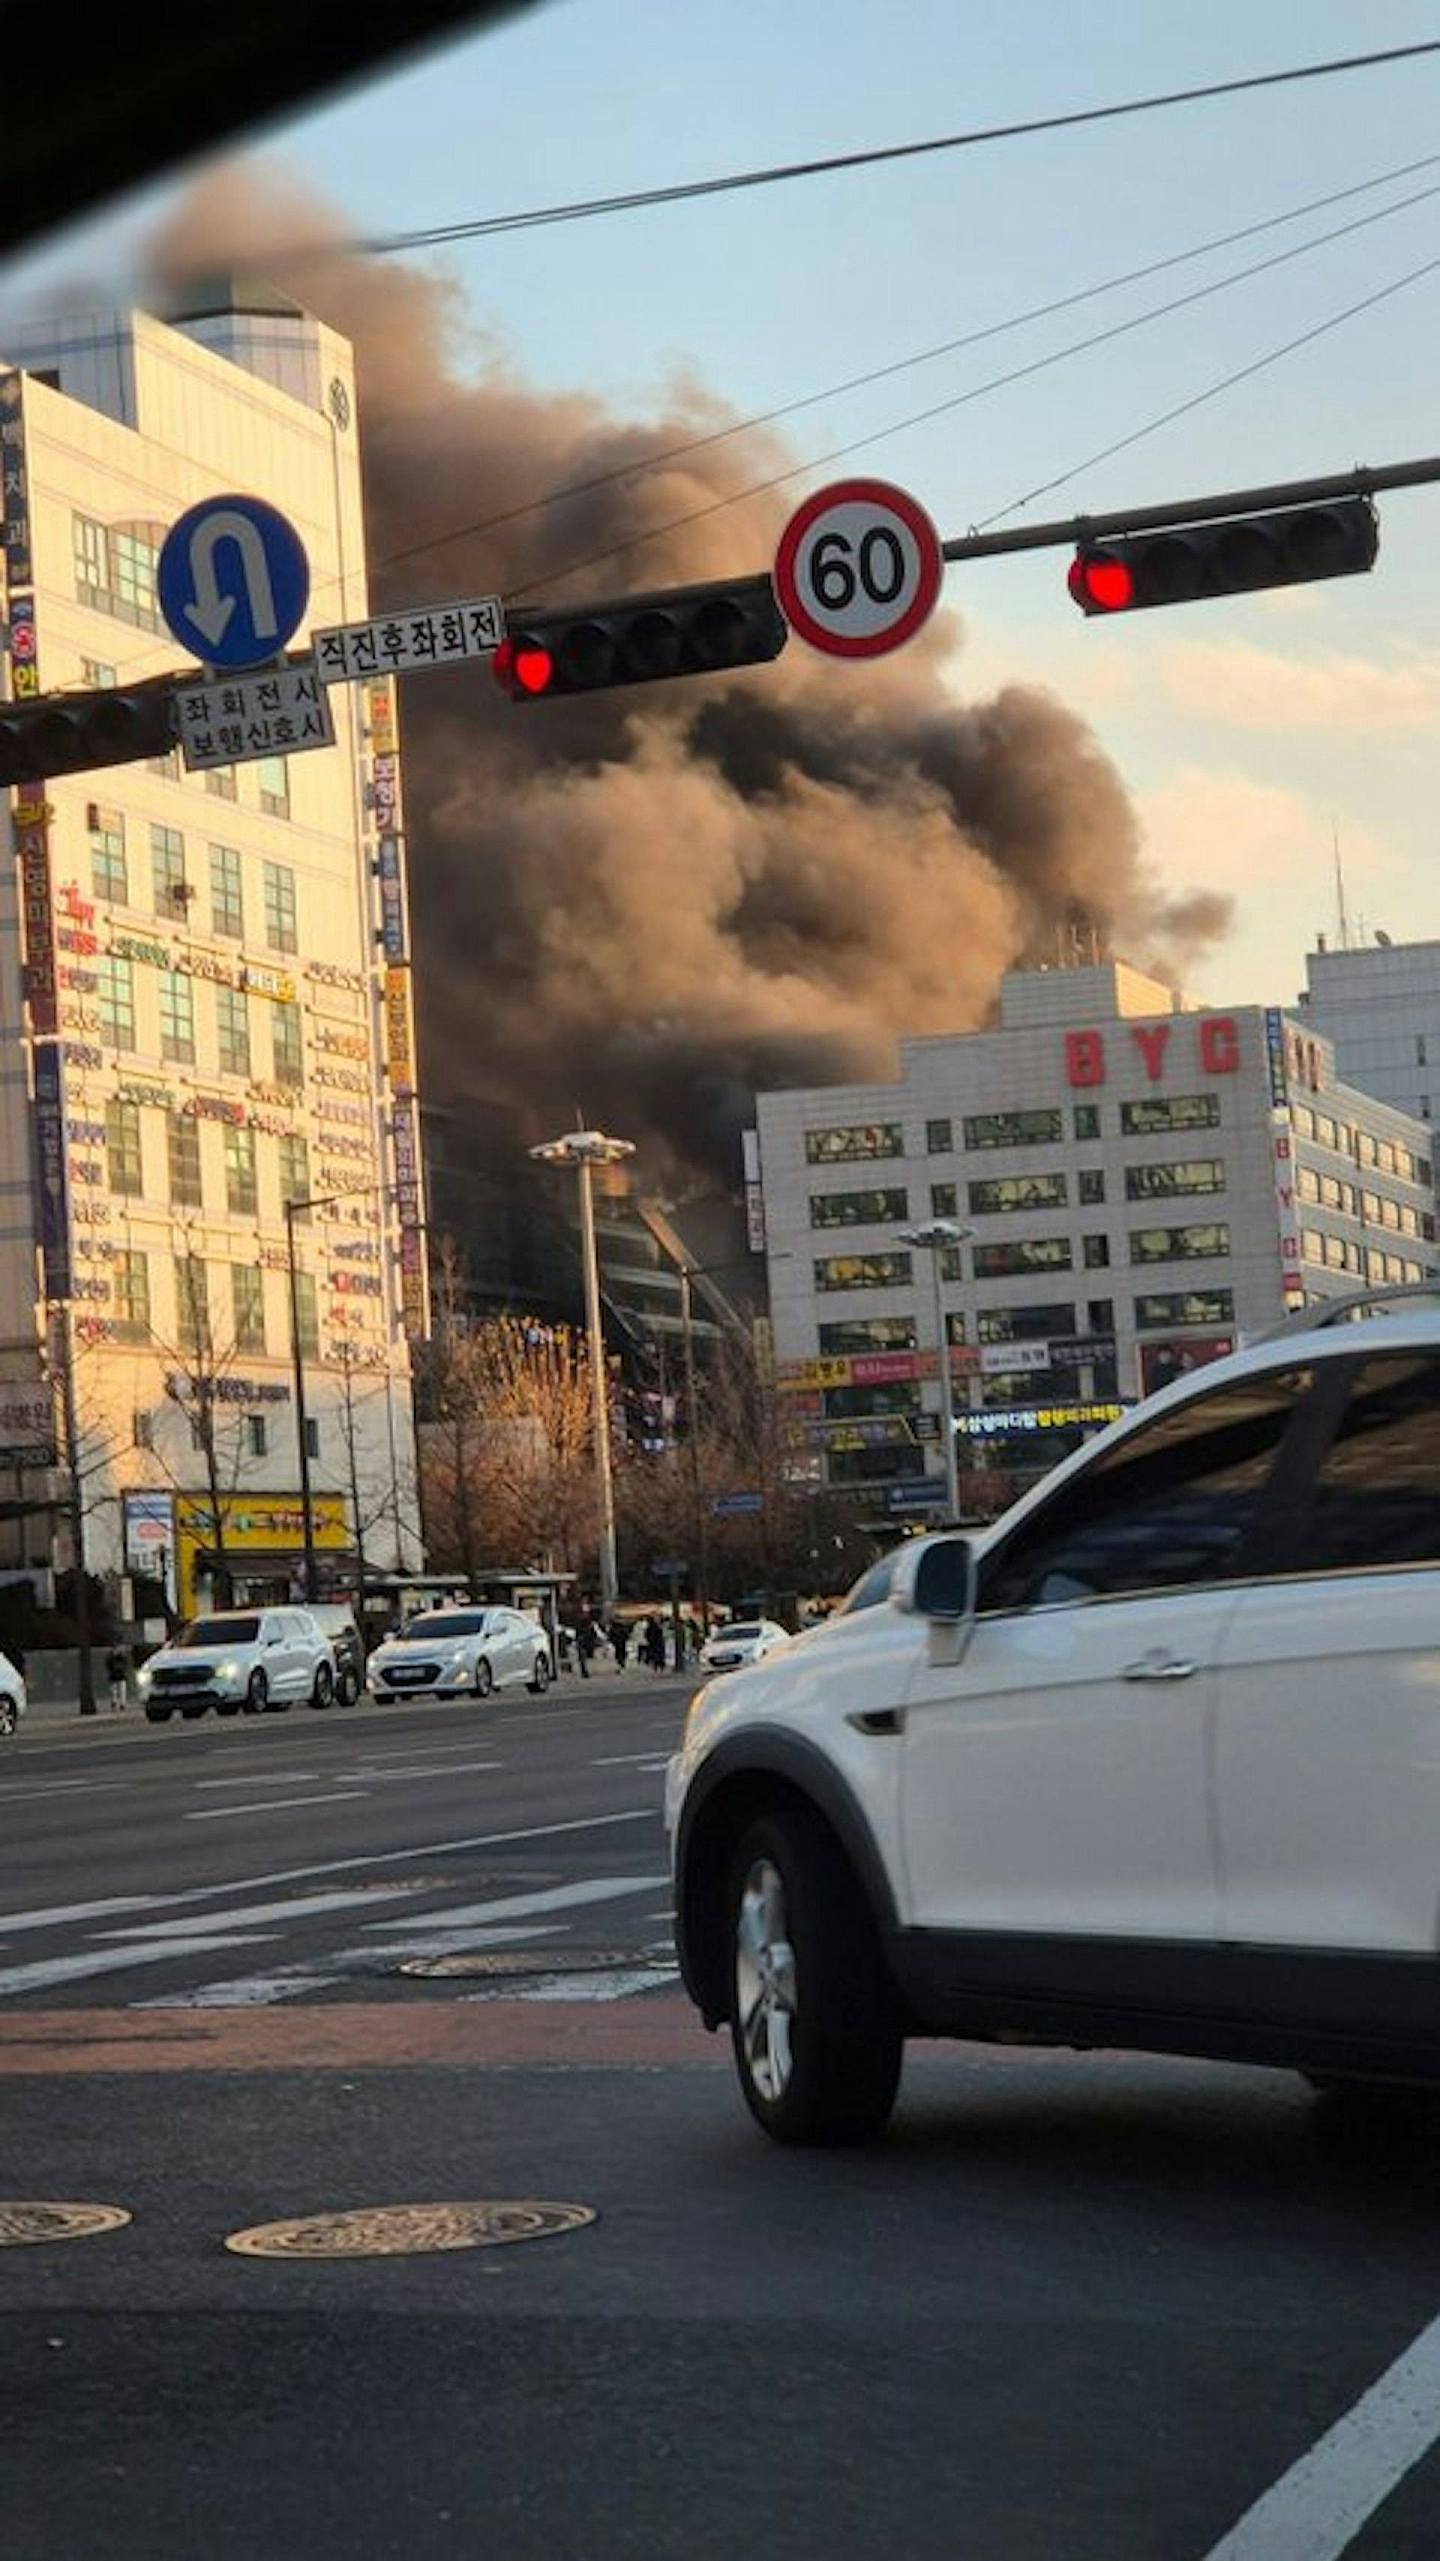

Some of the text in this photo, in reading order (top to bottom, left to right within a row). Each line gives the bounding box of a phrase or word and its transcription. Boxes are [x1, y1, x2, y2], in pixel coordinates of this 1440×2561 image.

[811, 526, 905, 610] 60
[193, 709, 325, 757] 보행신호시
[1064, 1016, 1240, 1088] BYC
[1275, 1138, 1297, 1259] BYC
